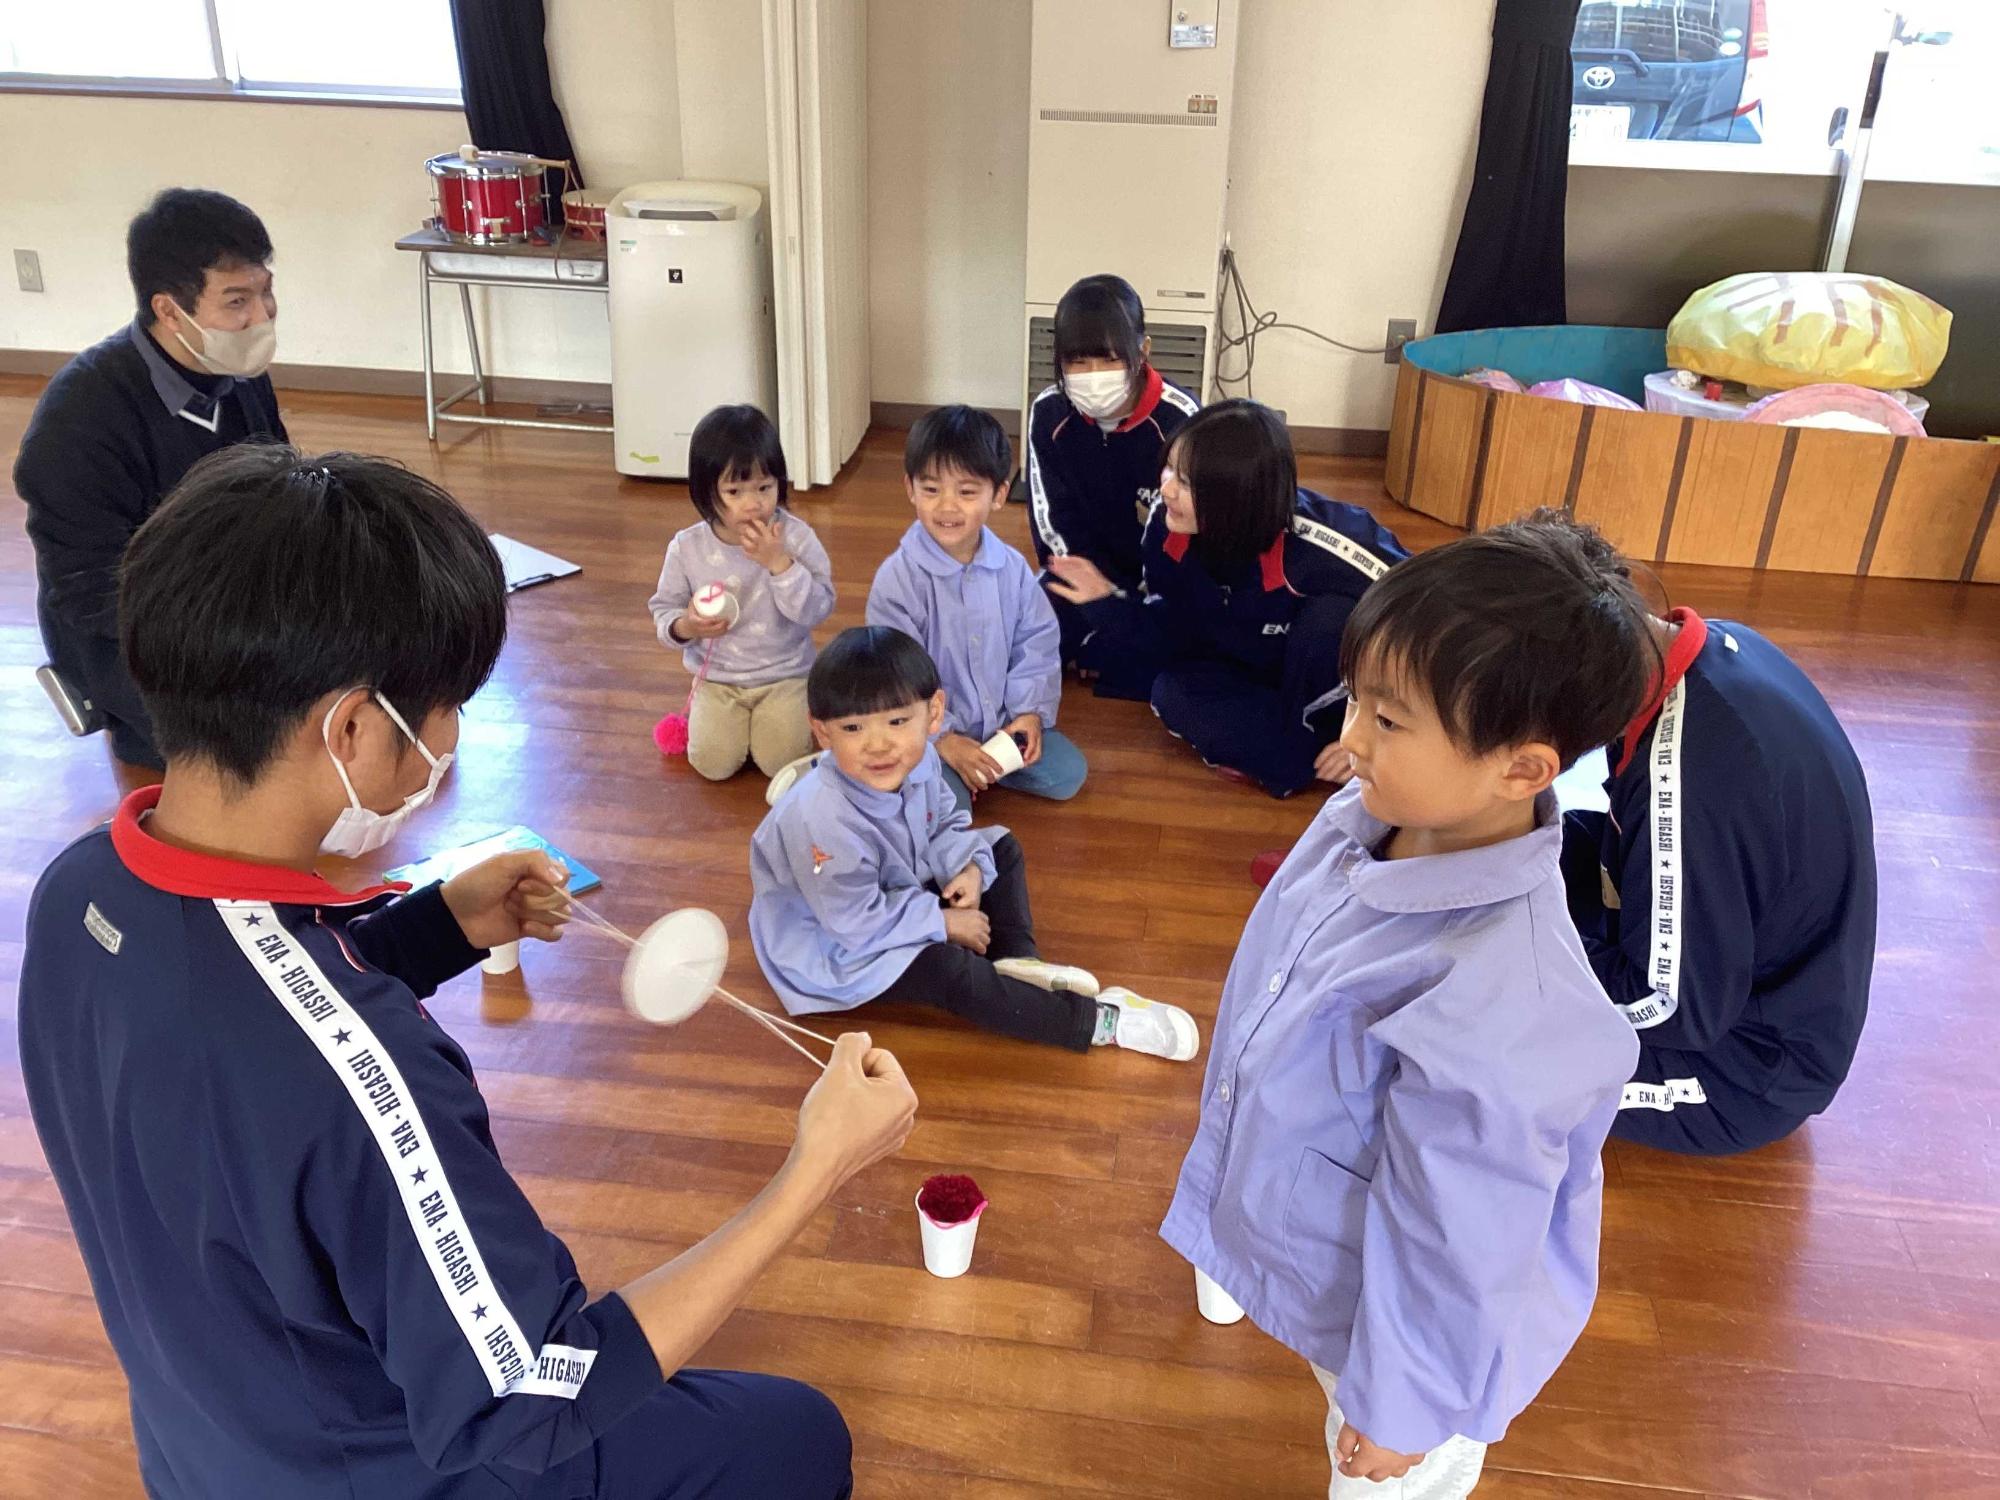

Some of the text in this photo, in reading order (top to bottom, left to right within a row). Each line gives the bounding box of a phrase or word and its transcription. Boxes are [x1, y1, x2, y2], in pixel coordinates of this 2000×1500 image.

[1658, 791, 1672, 809] ENA
[1658, 816, 1673, 852] HIGASHI
[1659, 875, 1674, 911] HIGASHI
[1659, 917, 1673, 935] ENA
[256, 933, 291, 964] ENA
[280, 965, 339, 1023] HIGASHI
[347, 1048, 402, 1117] HIGASHI
[1639, 1091, 1656, 1104] ENA
[390, 1119, 421, 1159] ENA
[418, 1189, 448, 1228] ENA
[435, 1229, 479, 1296] HIGASHI
[537, 1356, 586, 1385] HIGASHI
